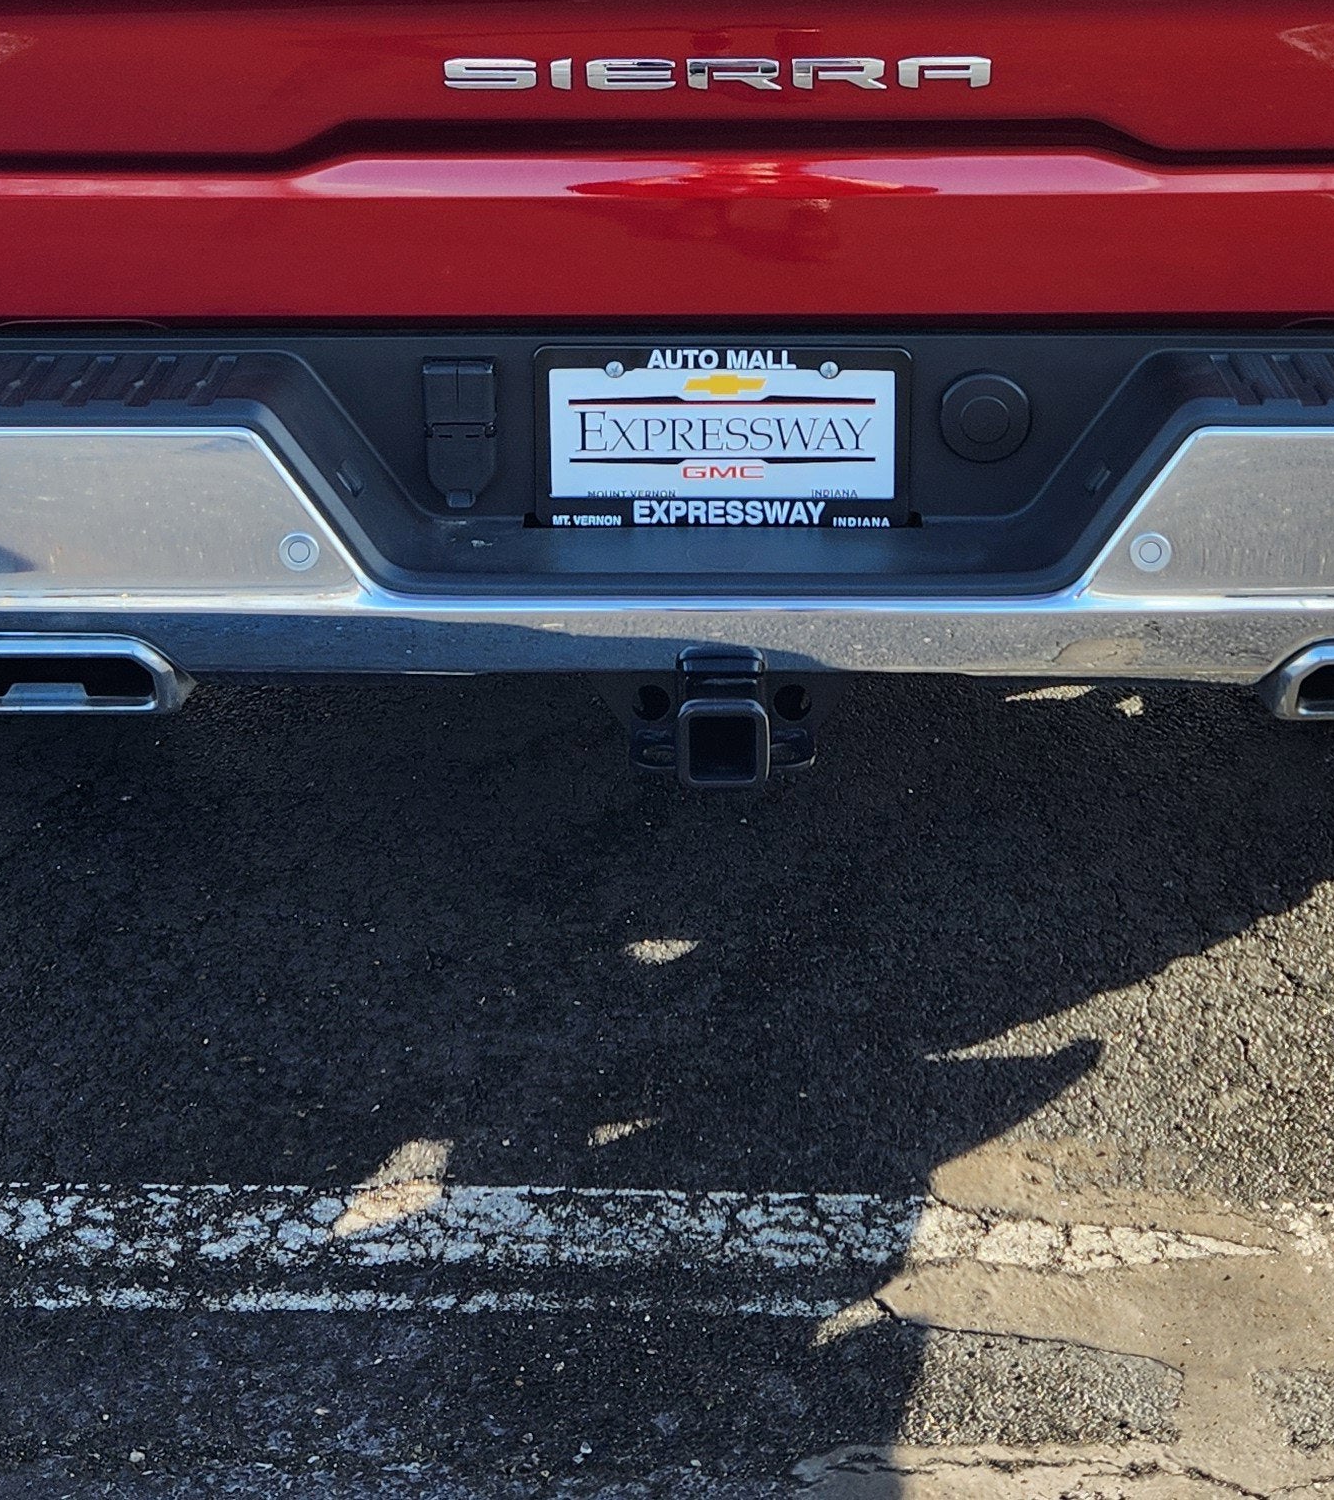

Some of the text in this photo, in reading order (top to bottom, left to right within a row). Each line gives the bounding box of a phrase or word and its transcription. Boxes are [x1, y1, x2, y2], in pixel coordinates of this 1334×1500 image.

[442, 56, 992, 91] SIERRA
[646, 349, 797, 370] AUTO MALL
[574, 410, 872, 452] EXPRESSWAY
[682, 465, 764, 479] GMC
[587, 489, 676, 498] MOUNT VERNON
[811, 489, 858, 498] INDIANA
[633, 499, 826, 525] EXPRESSWAY
[552, 515, 622, 526] MT. VERNON
[832, 516, 890, 527] INDIANA
